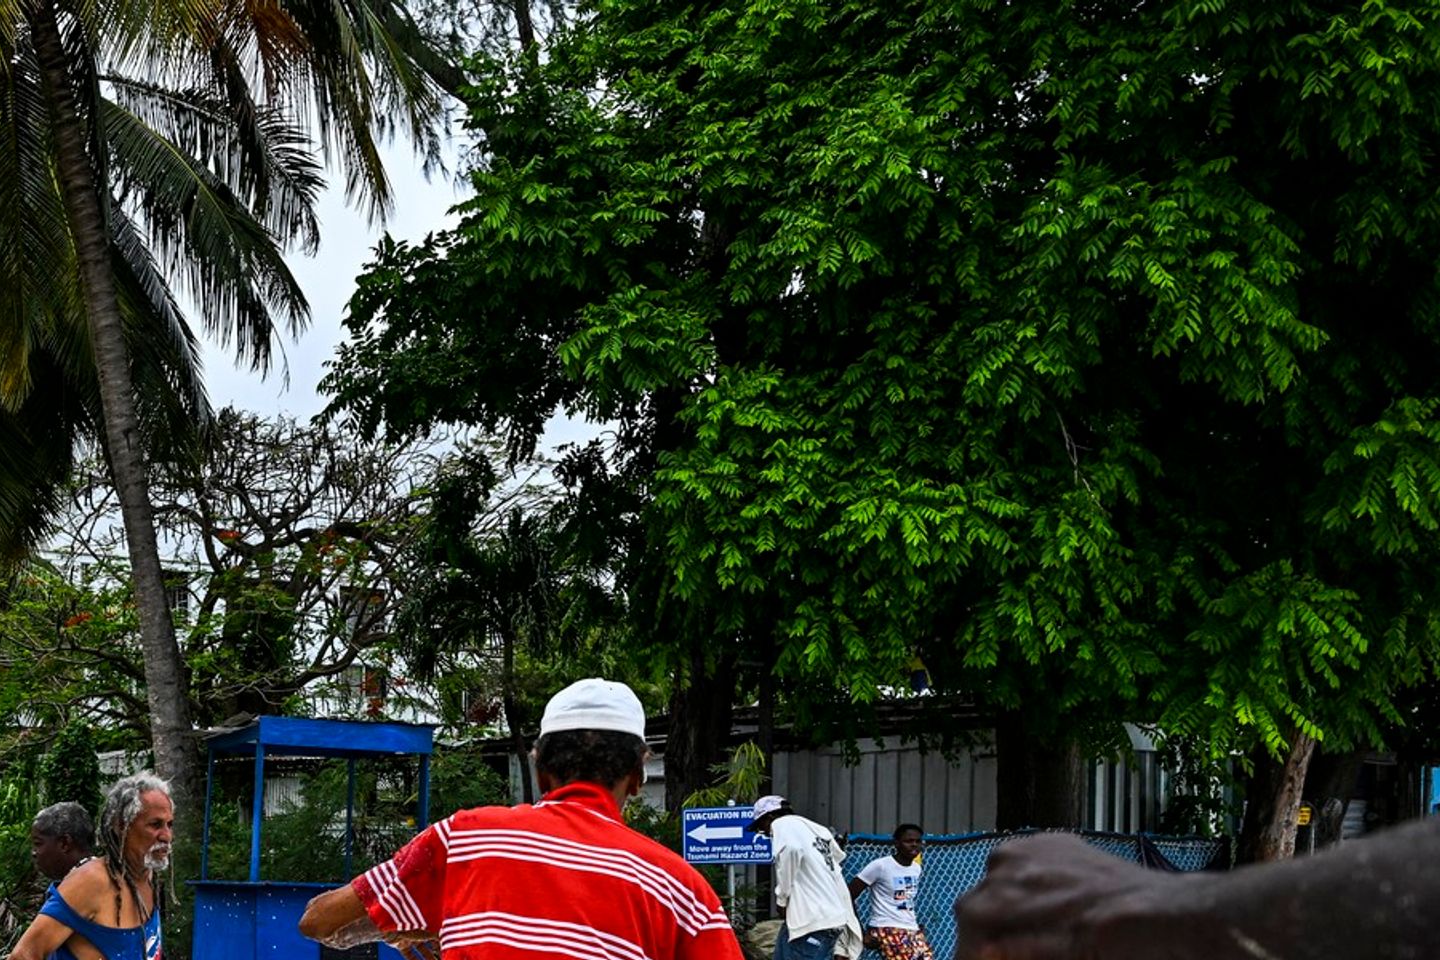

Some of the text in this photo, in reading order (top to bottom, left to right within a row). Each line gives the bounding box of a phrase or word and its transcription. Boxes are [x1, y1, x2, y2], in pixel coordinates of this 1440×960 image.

[686, 811, 754, 820] EVACUATION RO
[689, 845, 710, 853] Move
[711, 845, 732, 853] away
[720, 851, 748, 859] Hazard
[750, 851, 771, 859] Zone
